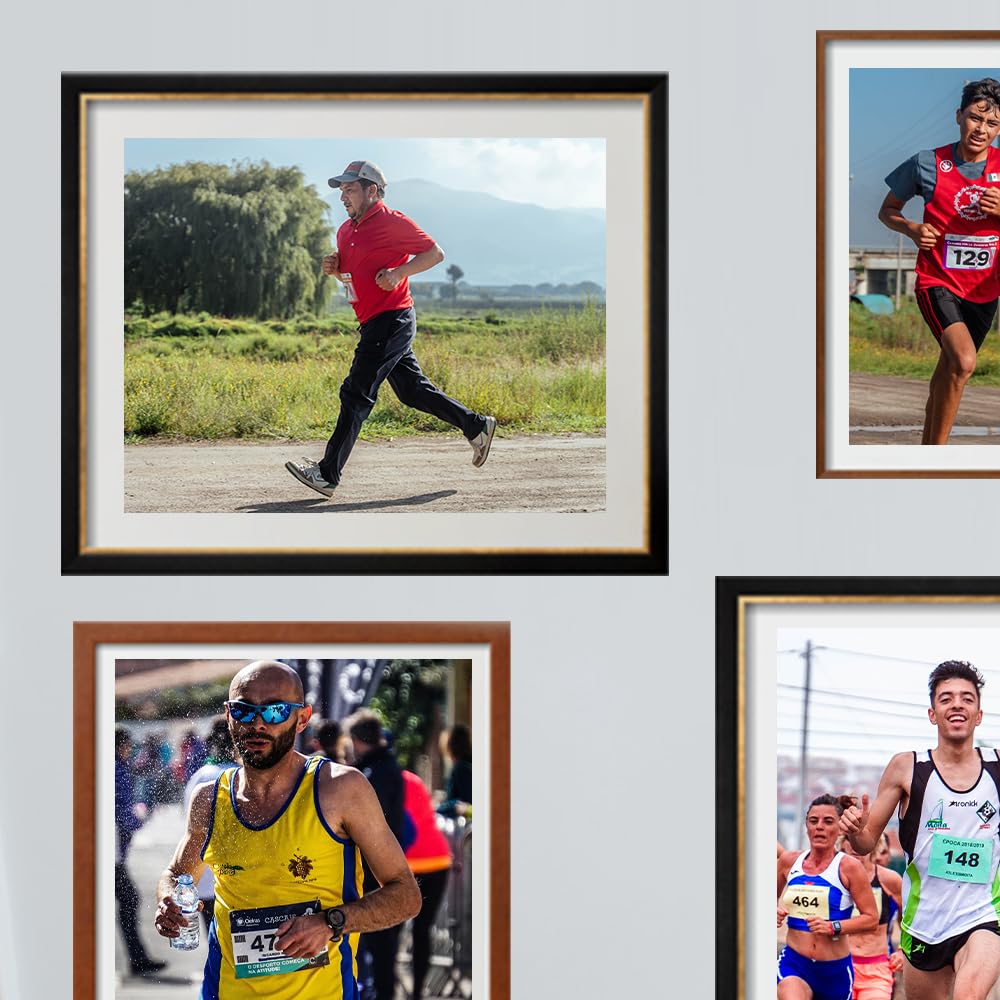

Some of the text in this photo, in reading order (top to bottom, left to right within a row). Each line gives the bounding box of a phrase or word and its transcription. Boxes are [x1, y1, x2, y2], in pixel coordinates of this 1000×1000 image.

[953, 249, 990, 266] 129
[944, 850, 980, 868] 148
[792, 896, 819, 908] 464
